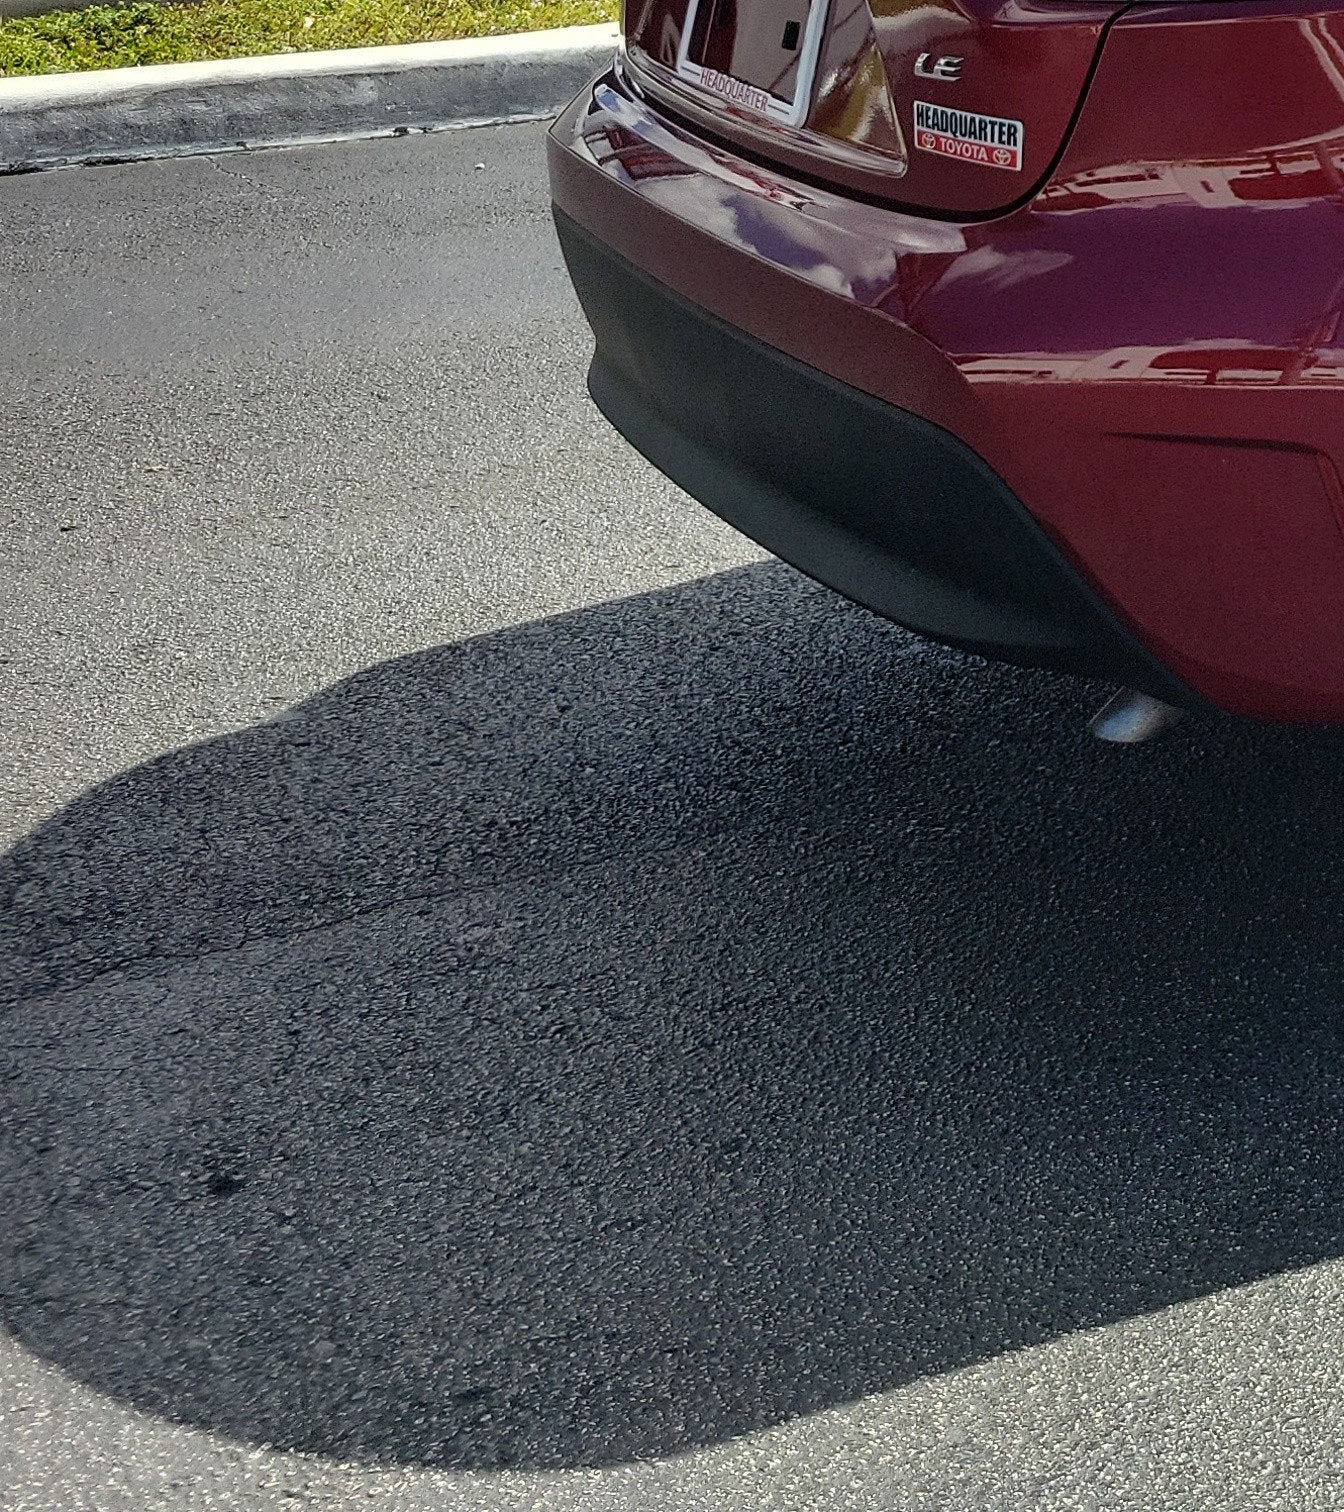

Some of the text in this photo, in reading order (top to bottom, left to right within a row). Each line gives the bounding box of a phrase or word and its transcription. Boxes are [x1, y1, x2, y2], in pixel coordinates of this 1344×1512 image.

[914, 52, 964, 82] LE
[700, 67, 768, 112] HEADQUARTER
[916, 103, 1018, 147] HEADQUARTER
[939, 137, 989, 161] TOYOTA
